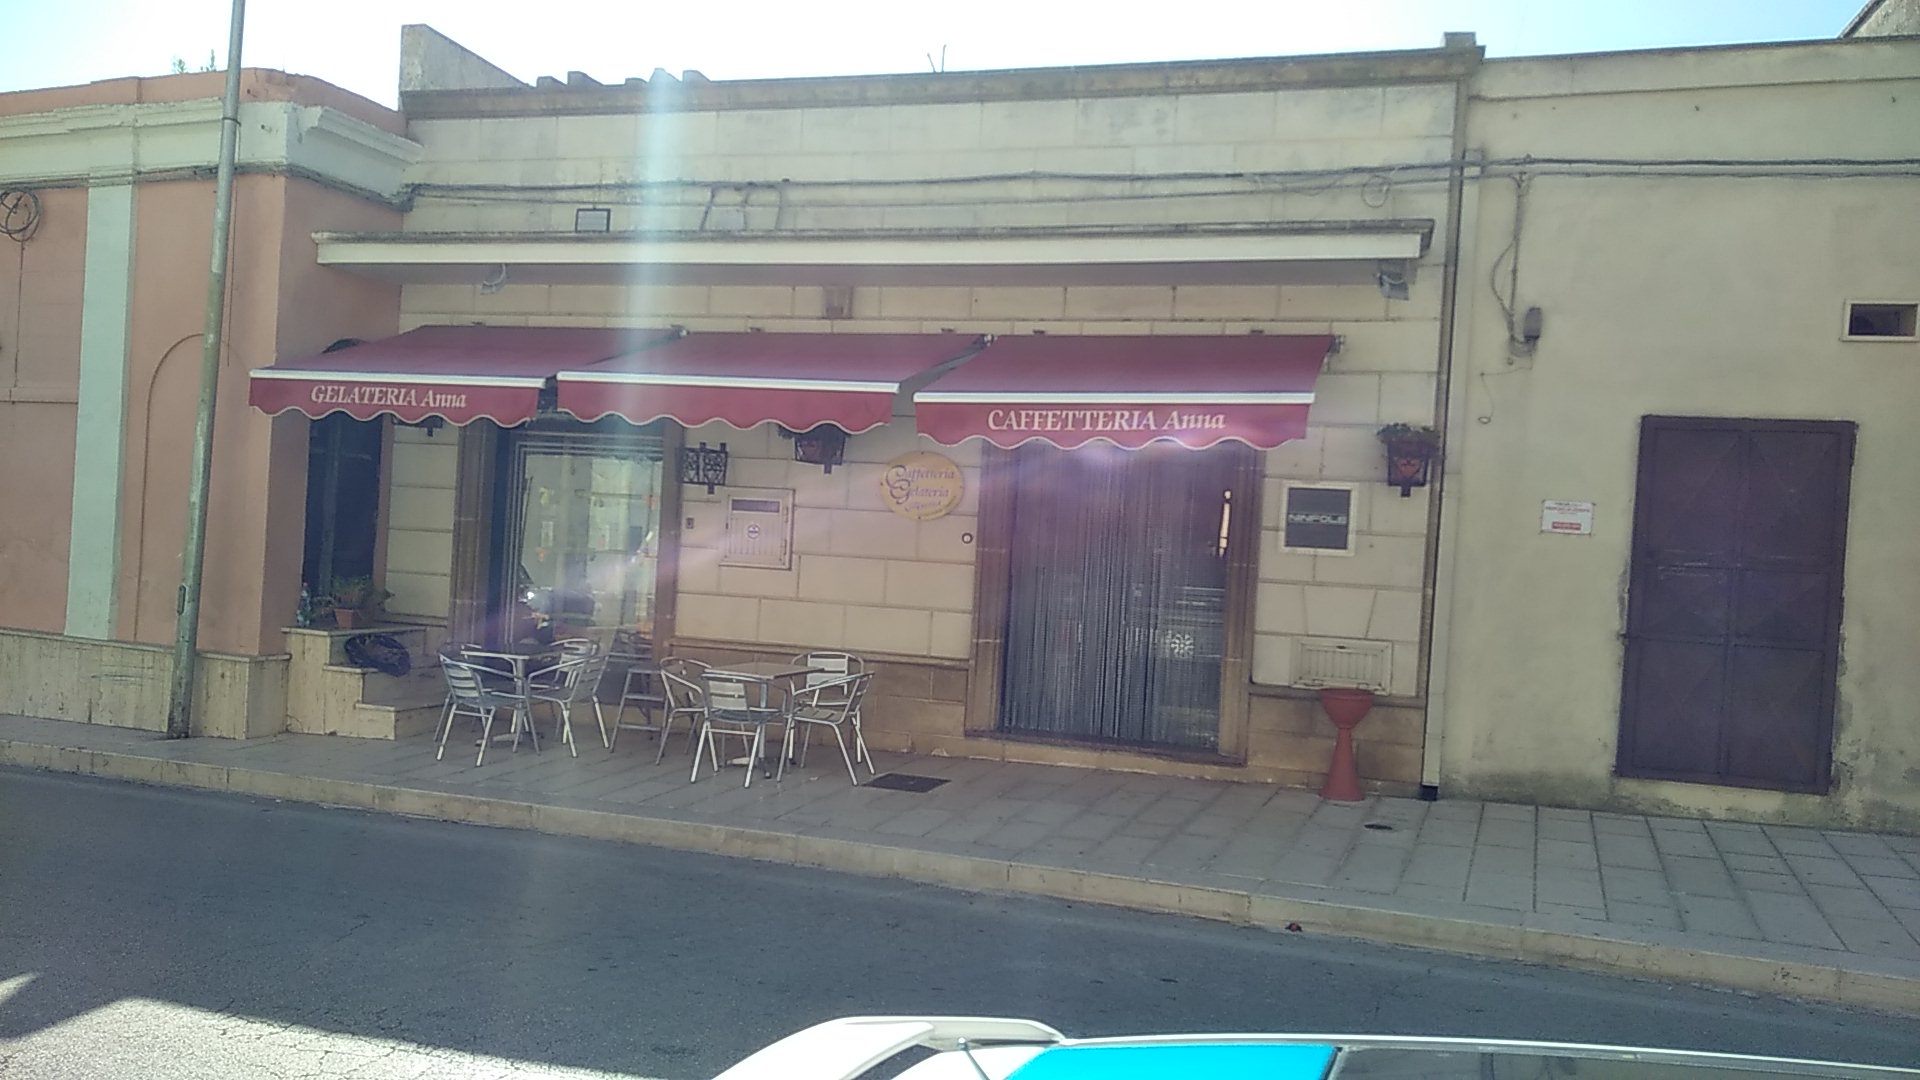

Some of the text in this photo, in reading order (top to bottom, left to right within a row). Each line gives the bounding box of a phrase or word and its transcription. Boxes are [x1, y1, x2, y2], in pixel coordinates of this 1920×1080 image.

[311, 385, 467, 407] GELATERIA Anna
[988, 409, 1226, 431] CAFFETTERIA Anna
[886, 464, 955, 488] Caffetteria
[889, 480, 949, 504] Gelateria
